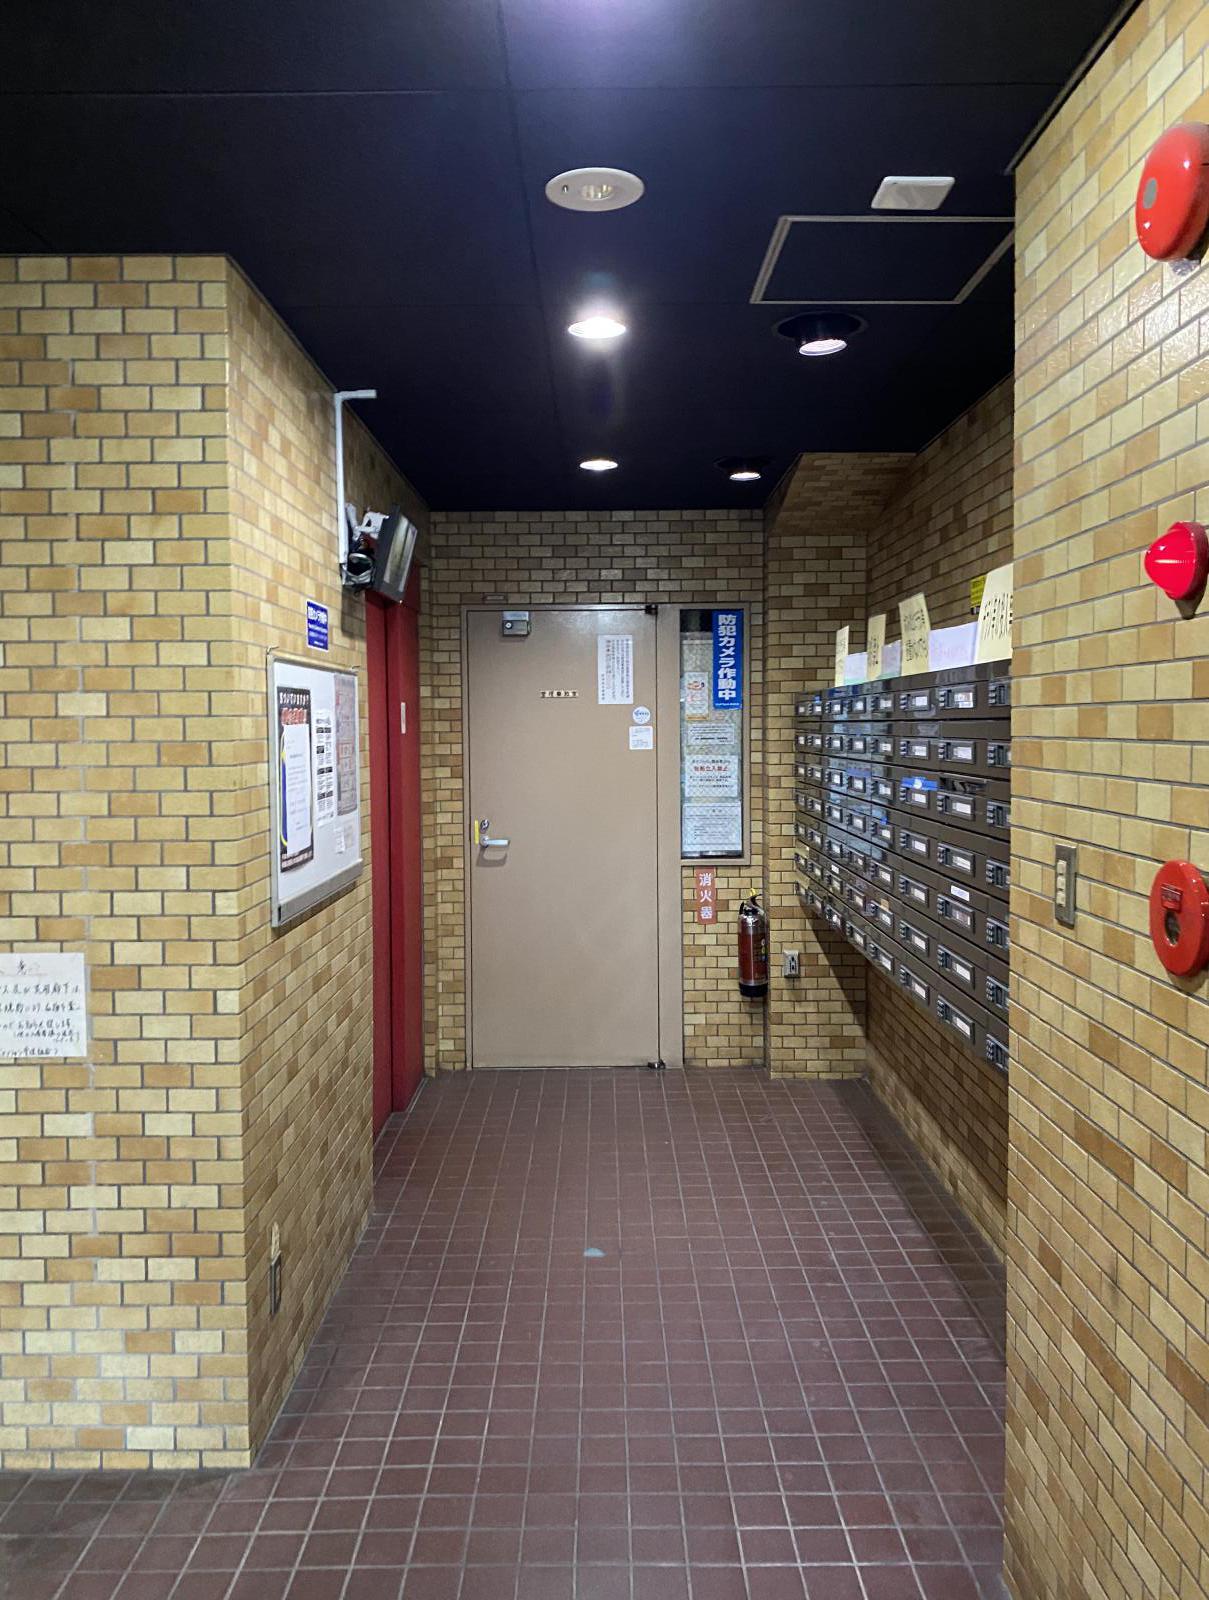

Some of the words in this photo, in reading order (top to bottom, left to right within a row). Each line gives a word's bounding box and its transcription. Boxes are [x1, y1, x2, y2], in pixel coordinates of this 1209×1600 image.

[718, 614, 737, 700] 防犯カメラ作動中
[699, 873, 713, 919] 消火器
